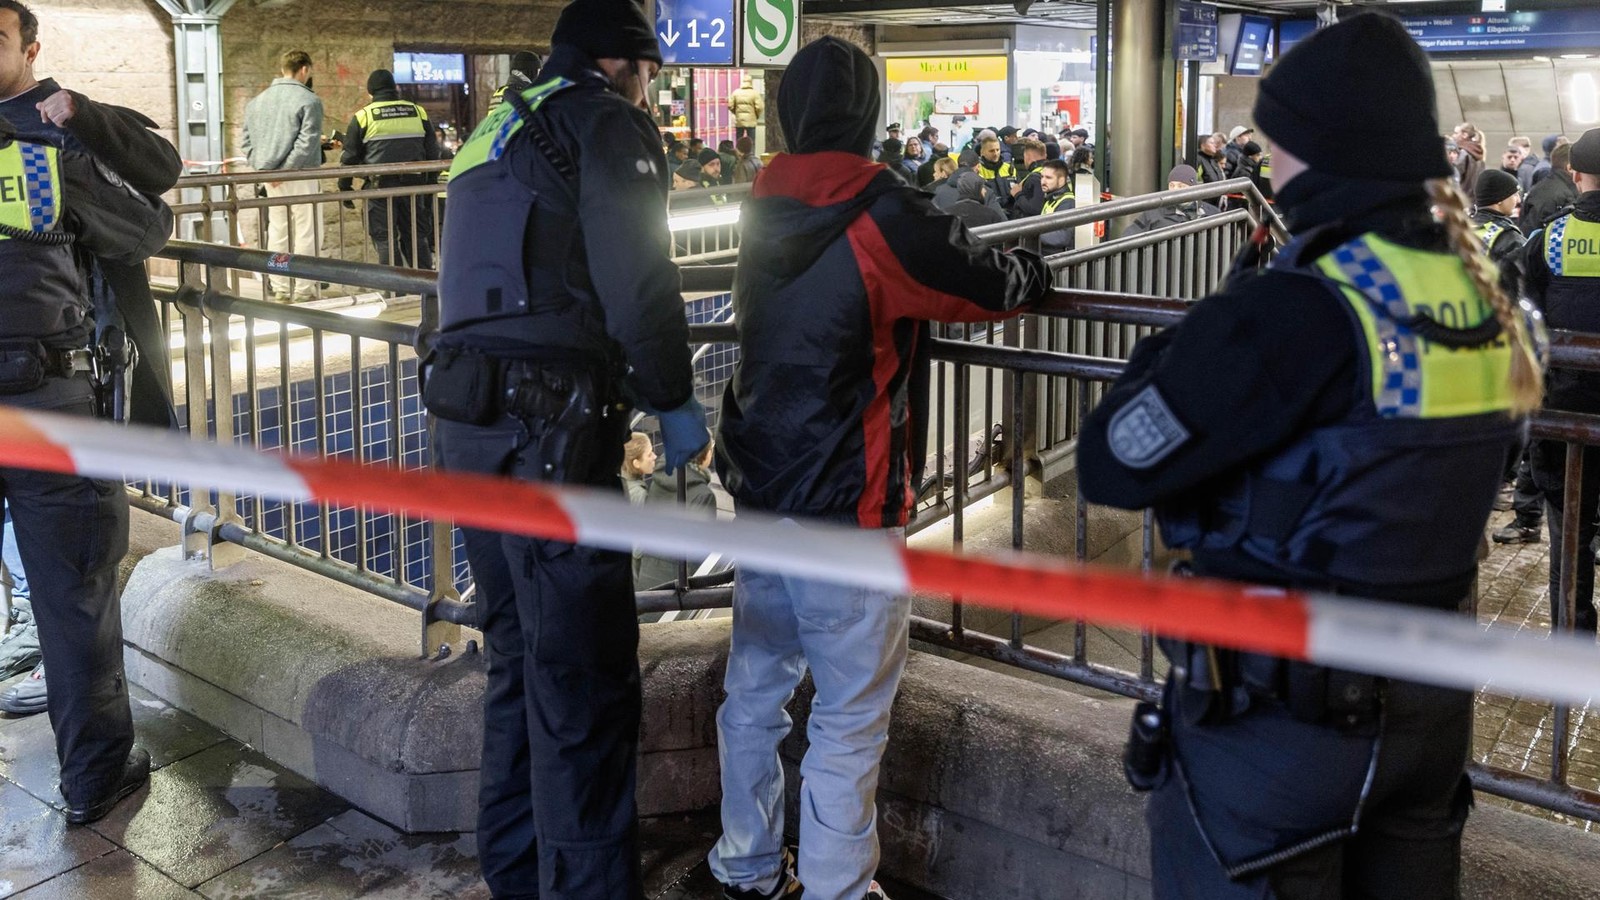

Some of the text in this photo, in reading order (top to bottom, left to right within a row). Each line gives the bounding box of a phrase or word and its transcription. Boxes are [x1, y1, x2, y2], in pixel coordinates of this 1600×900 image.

[1433, 18, 1453, 26] Wedel
[687, 18, 726, 47] 1-2
[1406, 28, 1424, 36] berg
[1487, 25, 1531, 33] Elbgaustraße
